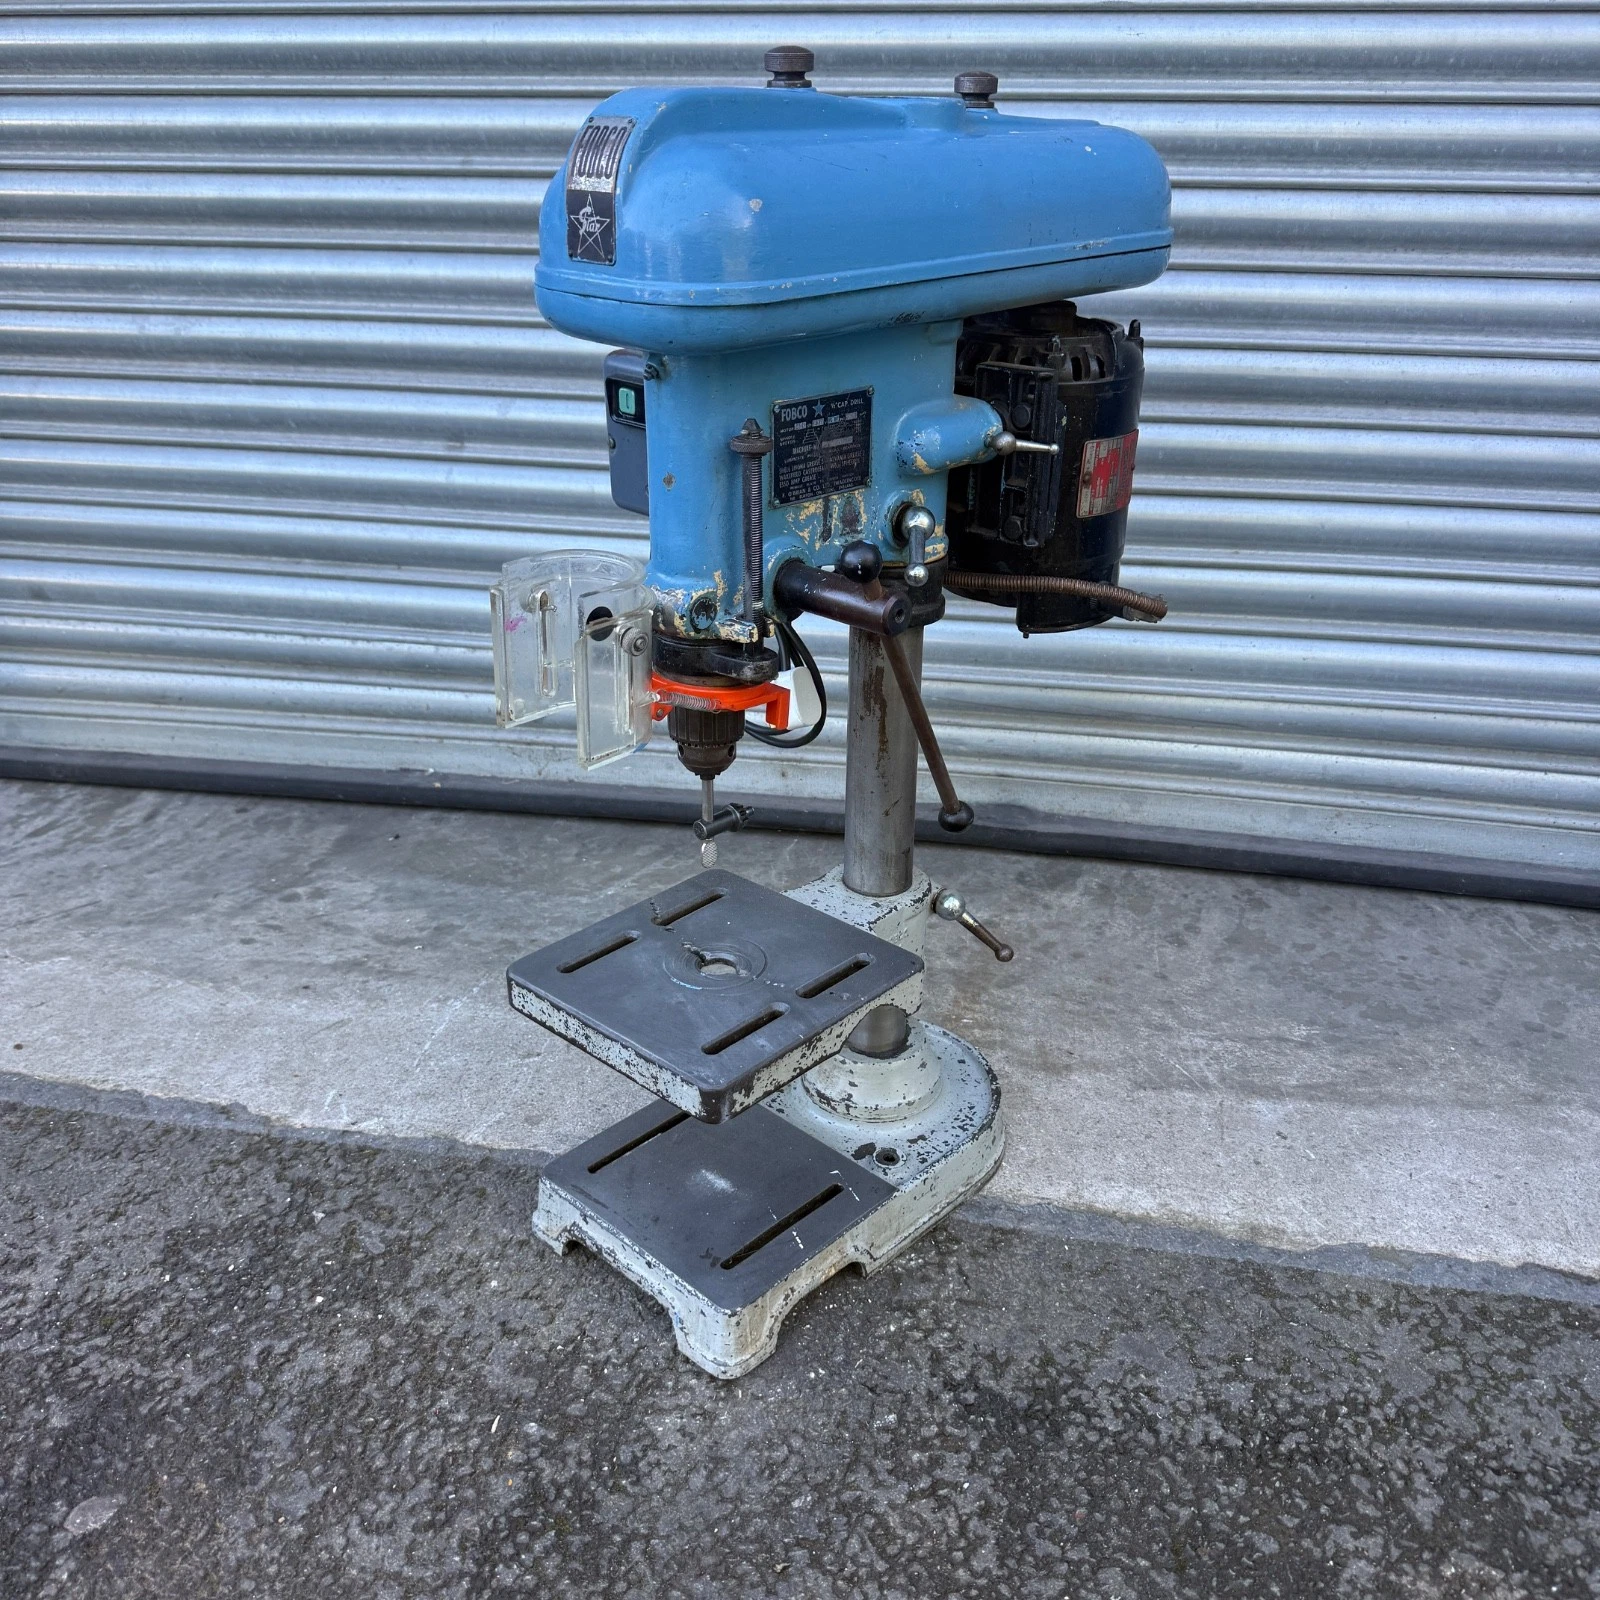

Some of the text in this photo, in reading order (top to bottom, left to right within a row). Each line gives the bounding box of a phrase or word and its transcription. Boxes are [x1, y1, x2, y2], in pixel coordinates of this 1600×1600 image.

[572, 125, 628, 179] FOBCO
[579, 206, 601, 234] Star
[850, 398, 864, 406] DRILL
[781, 405, 808, 422] FOBCO
